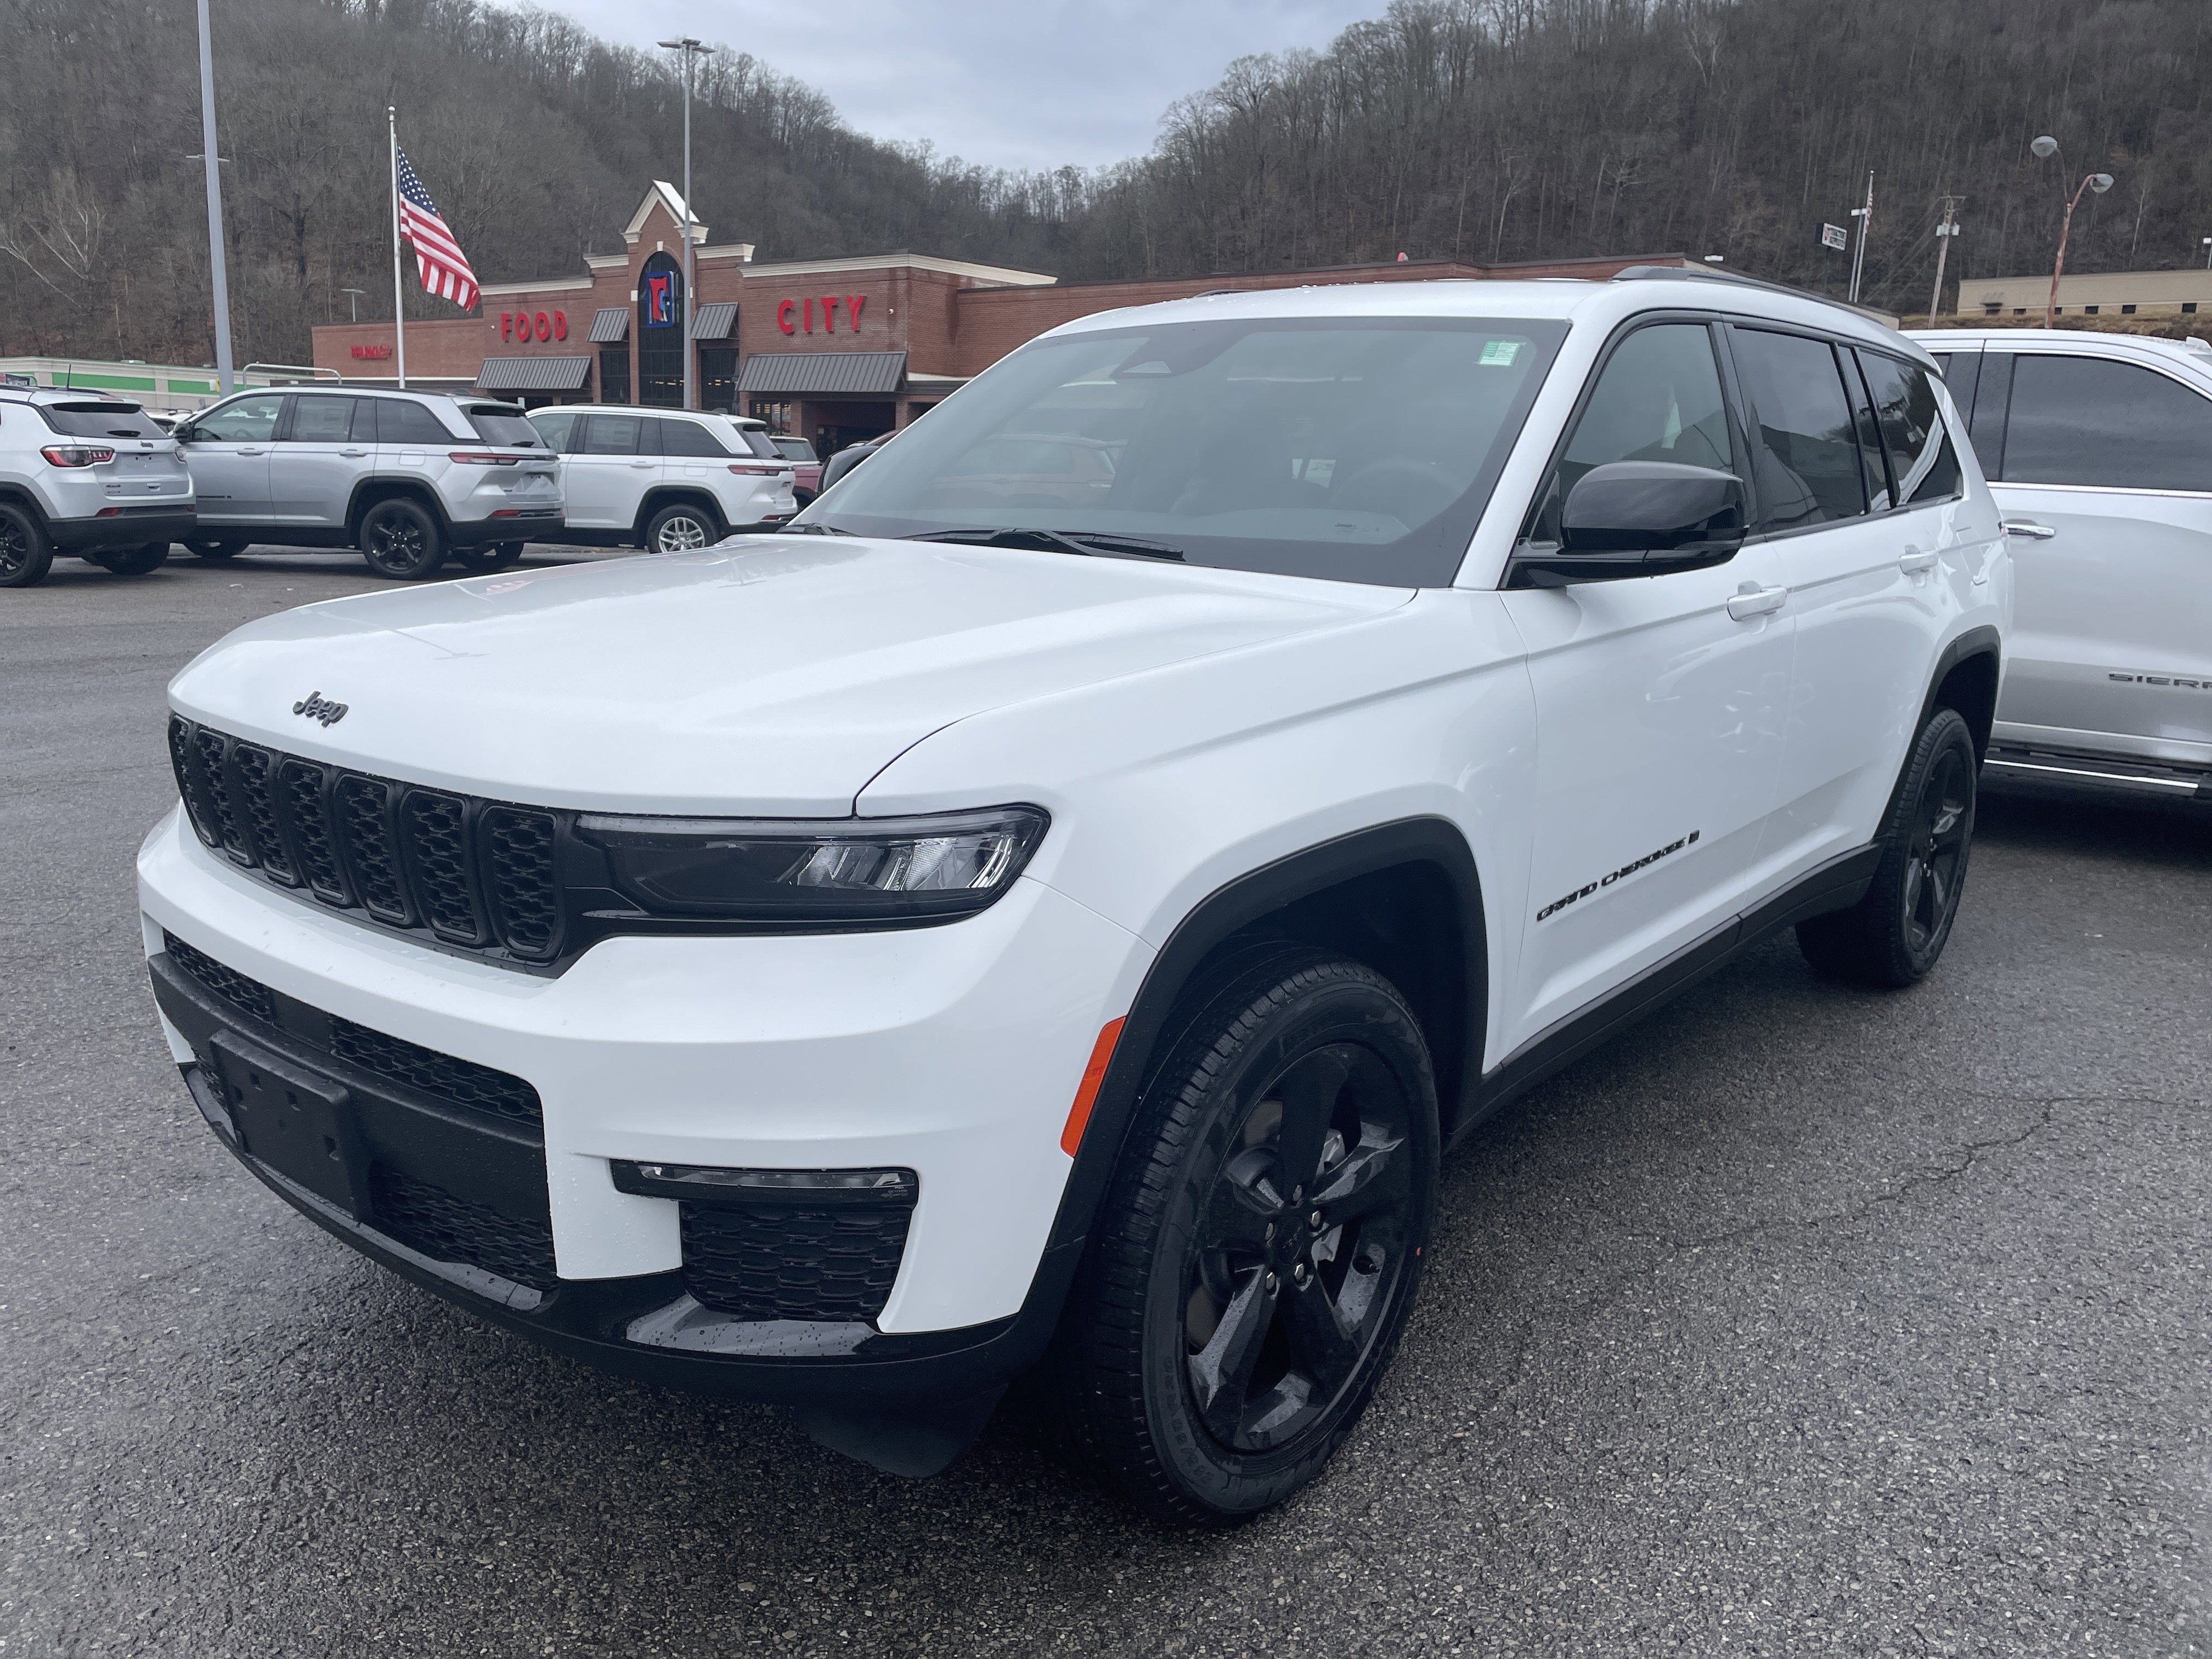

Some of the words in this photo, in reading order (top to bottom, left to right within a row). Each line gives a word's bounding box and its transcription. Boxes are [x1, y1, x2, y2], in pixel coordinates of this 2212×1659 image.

[501, 310, 567, 342] FOOD
[777, 295, 865, 334] CITY
[292, 691, 349, 728] Jeep
[1537, 882, 1598, 922] GRAND
